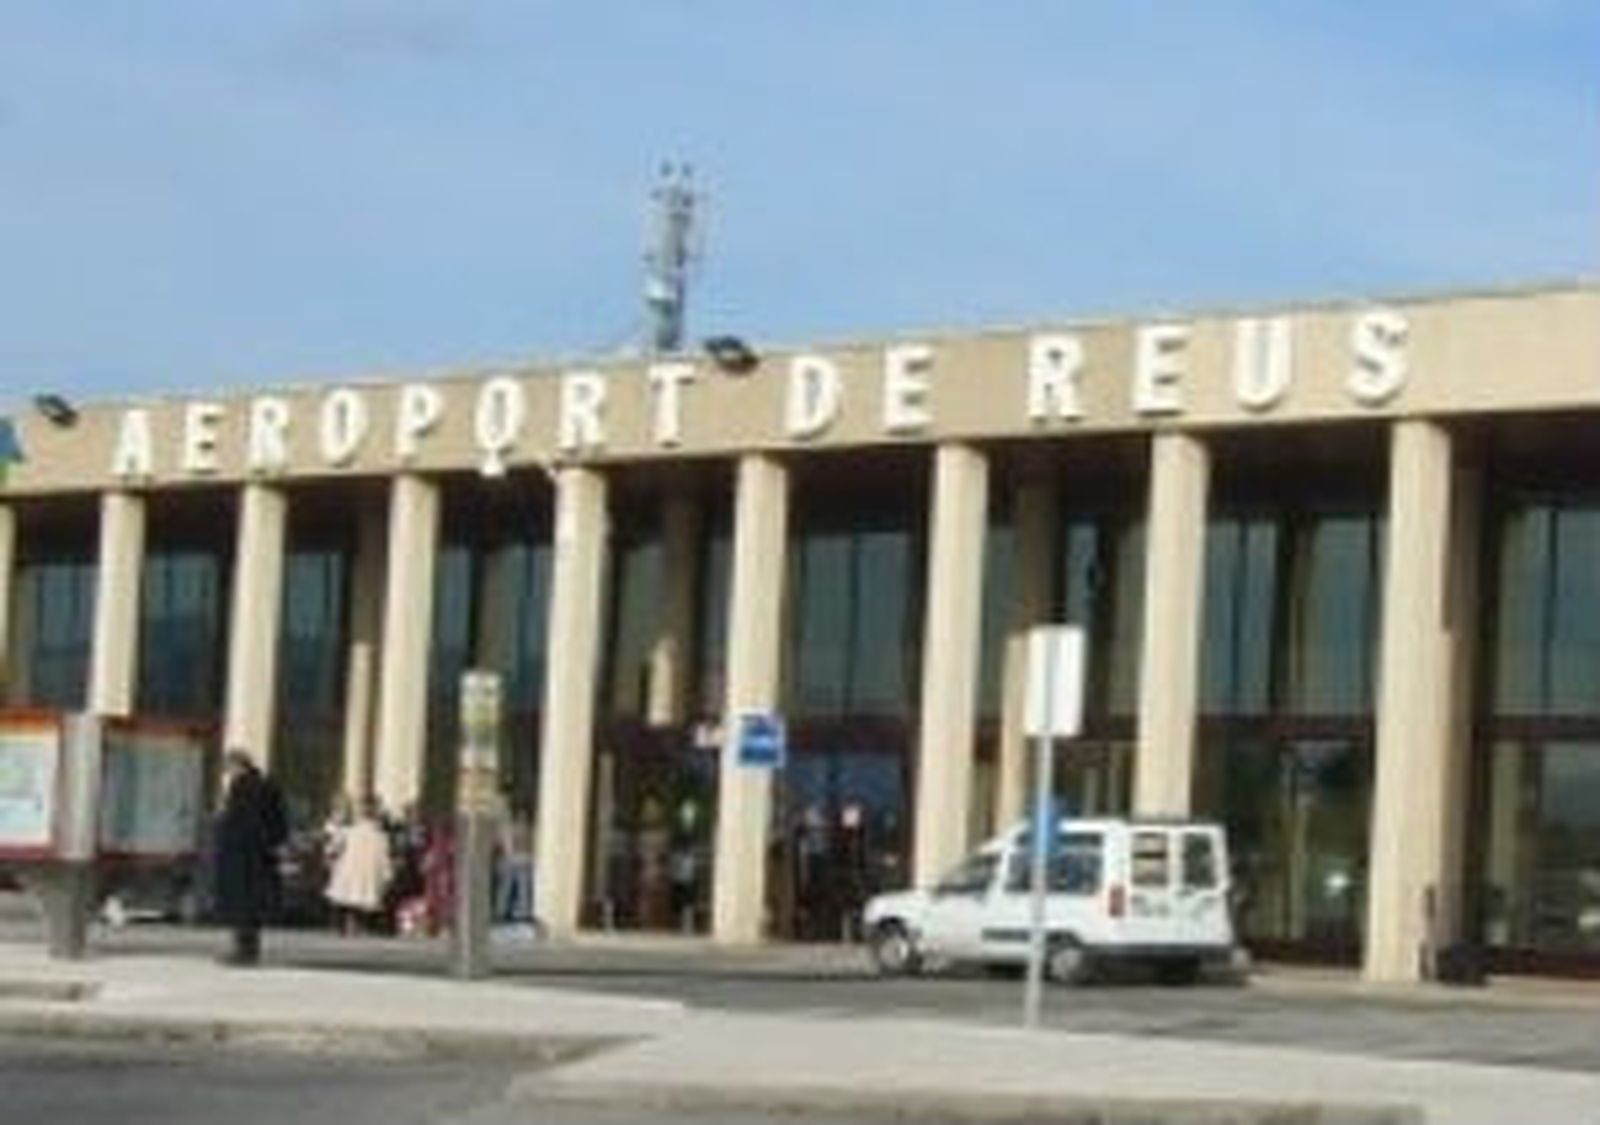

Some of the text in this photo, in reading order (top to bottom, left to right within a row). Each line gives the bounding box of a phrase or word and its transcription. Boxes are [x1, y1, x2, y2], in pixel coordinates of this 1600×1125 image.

[111, 309, 1410, 477] AEROPORT DE REUS
